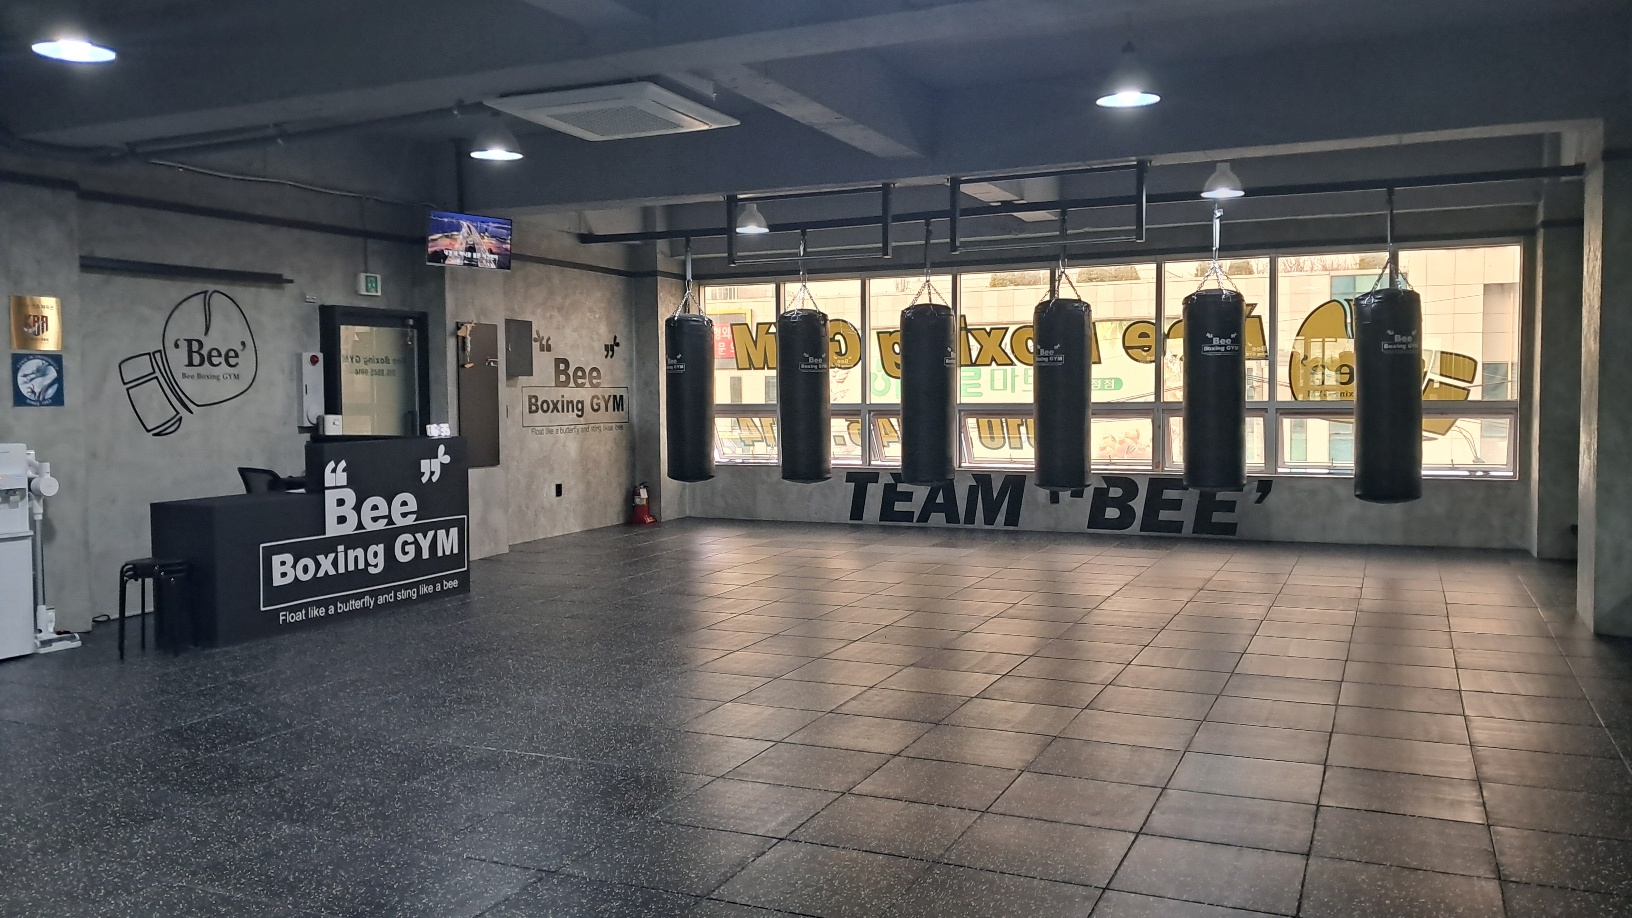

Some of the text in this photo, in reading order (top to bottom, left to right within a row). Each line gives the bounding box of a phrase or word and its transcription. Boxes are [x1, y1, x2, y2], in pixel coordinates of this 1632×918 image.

[1212, 337, 1232, 345] Bee
[1394, 334, 1413, 343] Bee
[808, 356, 823, 364] Bee
[1040, 348, 1055, 356] Bee
[527, 394, 625, 419] Boxing GYM
[844, 471, 1027, 527] TEAM
[271, 527, 459, 587] Boxing GYM
[279, 579, 459, 625] Float like a butterfly and sting like a bee
